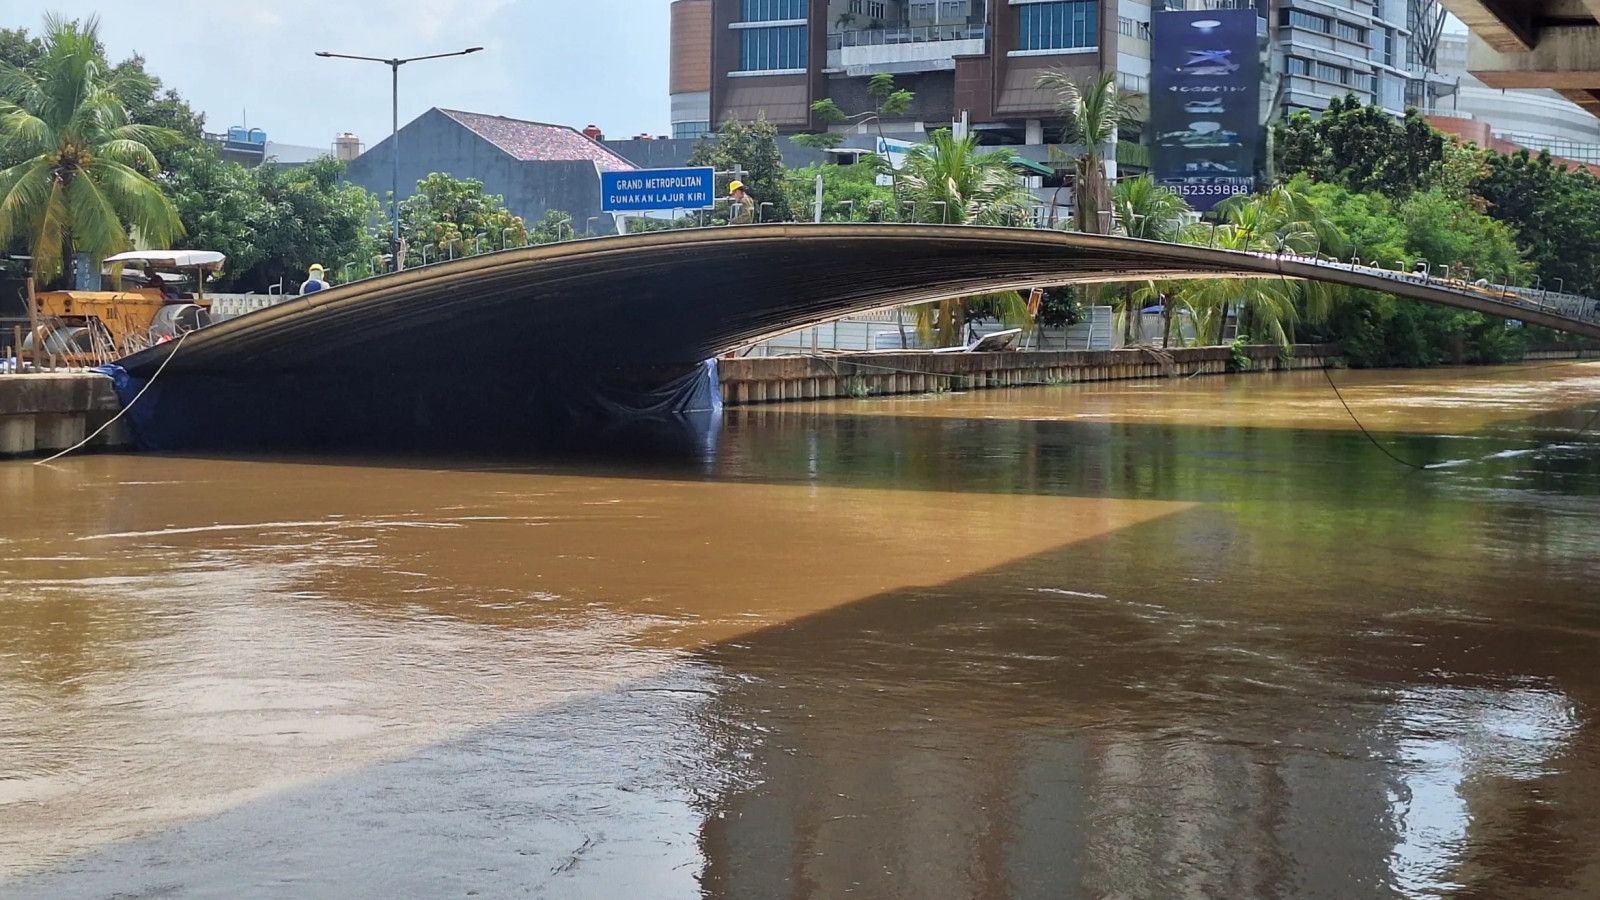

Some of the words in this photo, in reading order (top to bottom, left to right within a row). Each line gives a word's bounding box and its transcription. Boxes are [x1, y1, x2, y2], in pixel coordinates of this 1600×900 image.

[616, 180, 643, 190] GRAND
[645, 176, 702, 189] METROPOLITAN
[610, 194, 654, 204] GUNAKAN
[656, 193, 685, 203] LAJUR
[687, 192, 706, 201] KIRI
